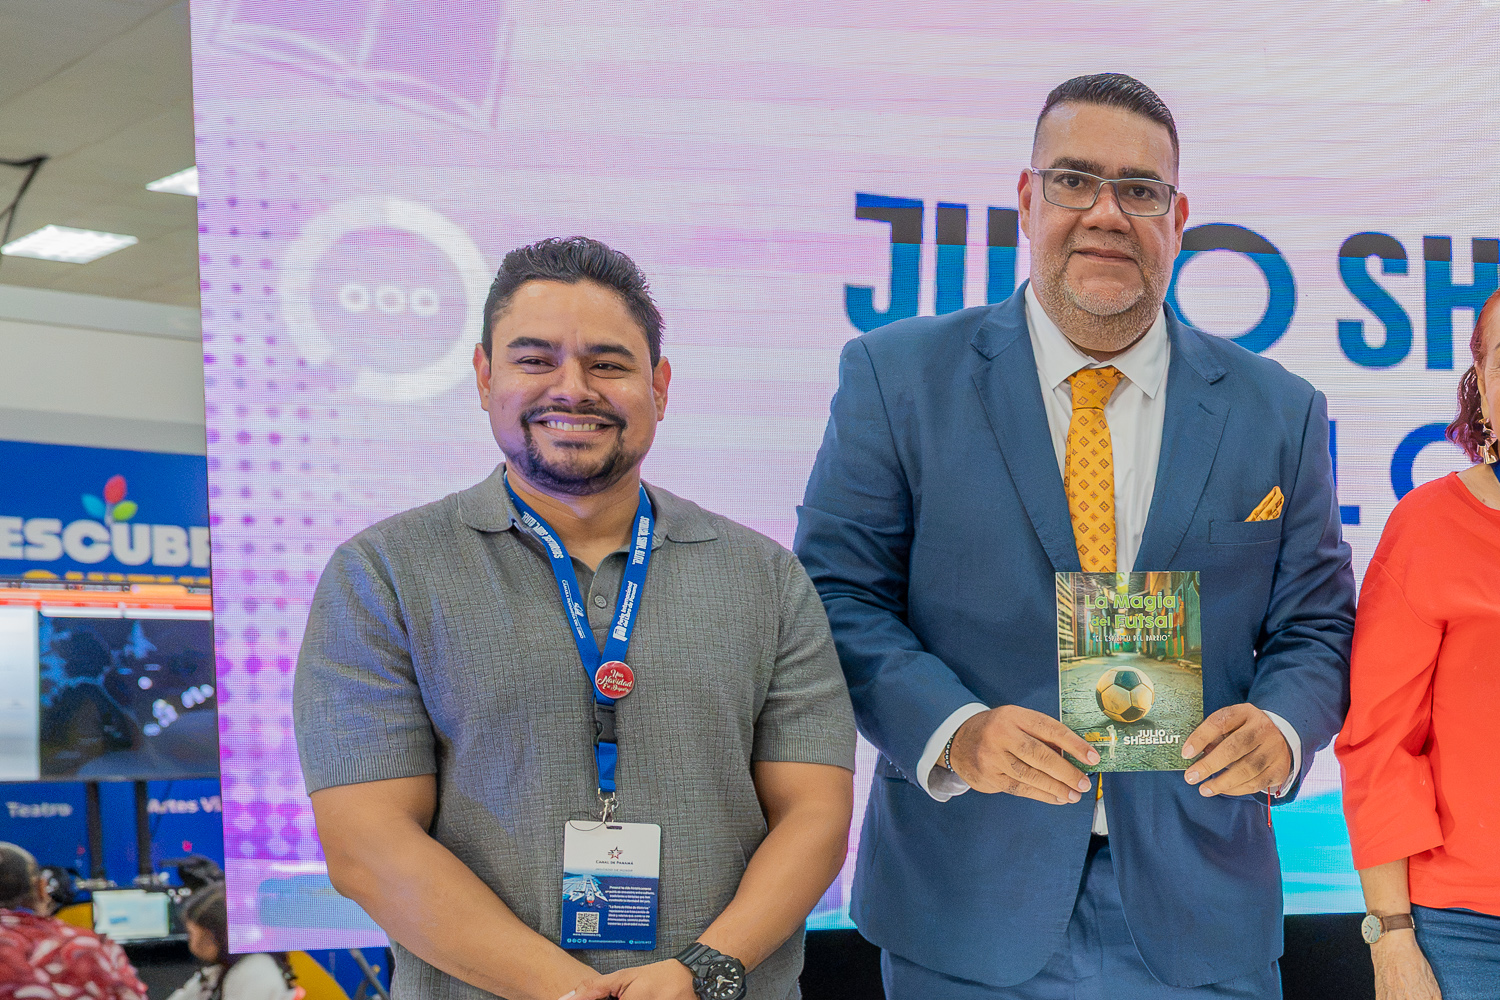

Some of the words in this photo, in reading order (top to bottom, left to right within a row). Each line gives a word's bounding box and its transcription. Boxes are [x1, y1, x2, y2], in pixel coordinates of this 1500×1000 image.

[1085, 594, 1108, 609] La
[1113, 592, 1176, 612] Magia
[1090, 615, 1110, 627] del
[1114, 612, 1174, 628] Futsal
[1138, 729, 1166, 738] JULIO
[1123, 735, 1180, 746] SHEBELUT
